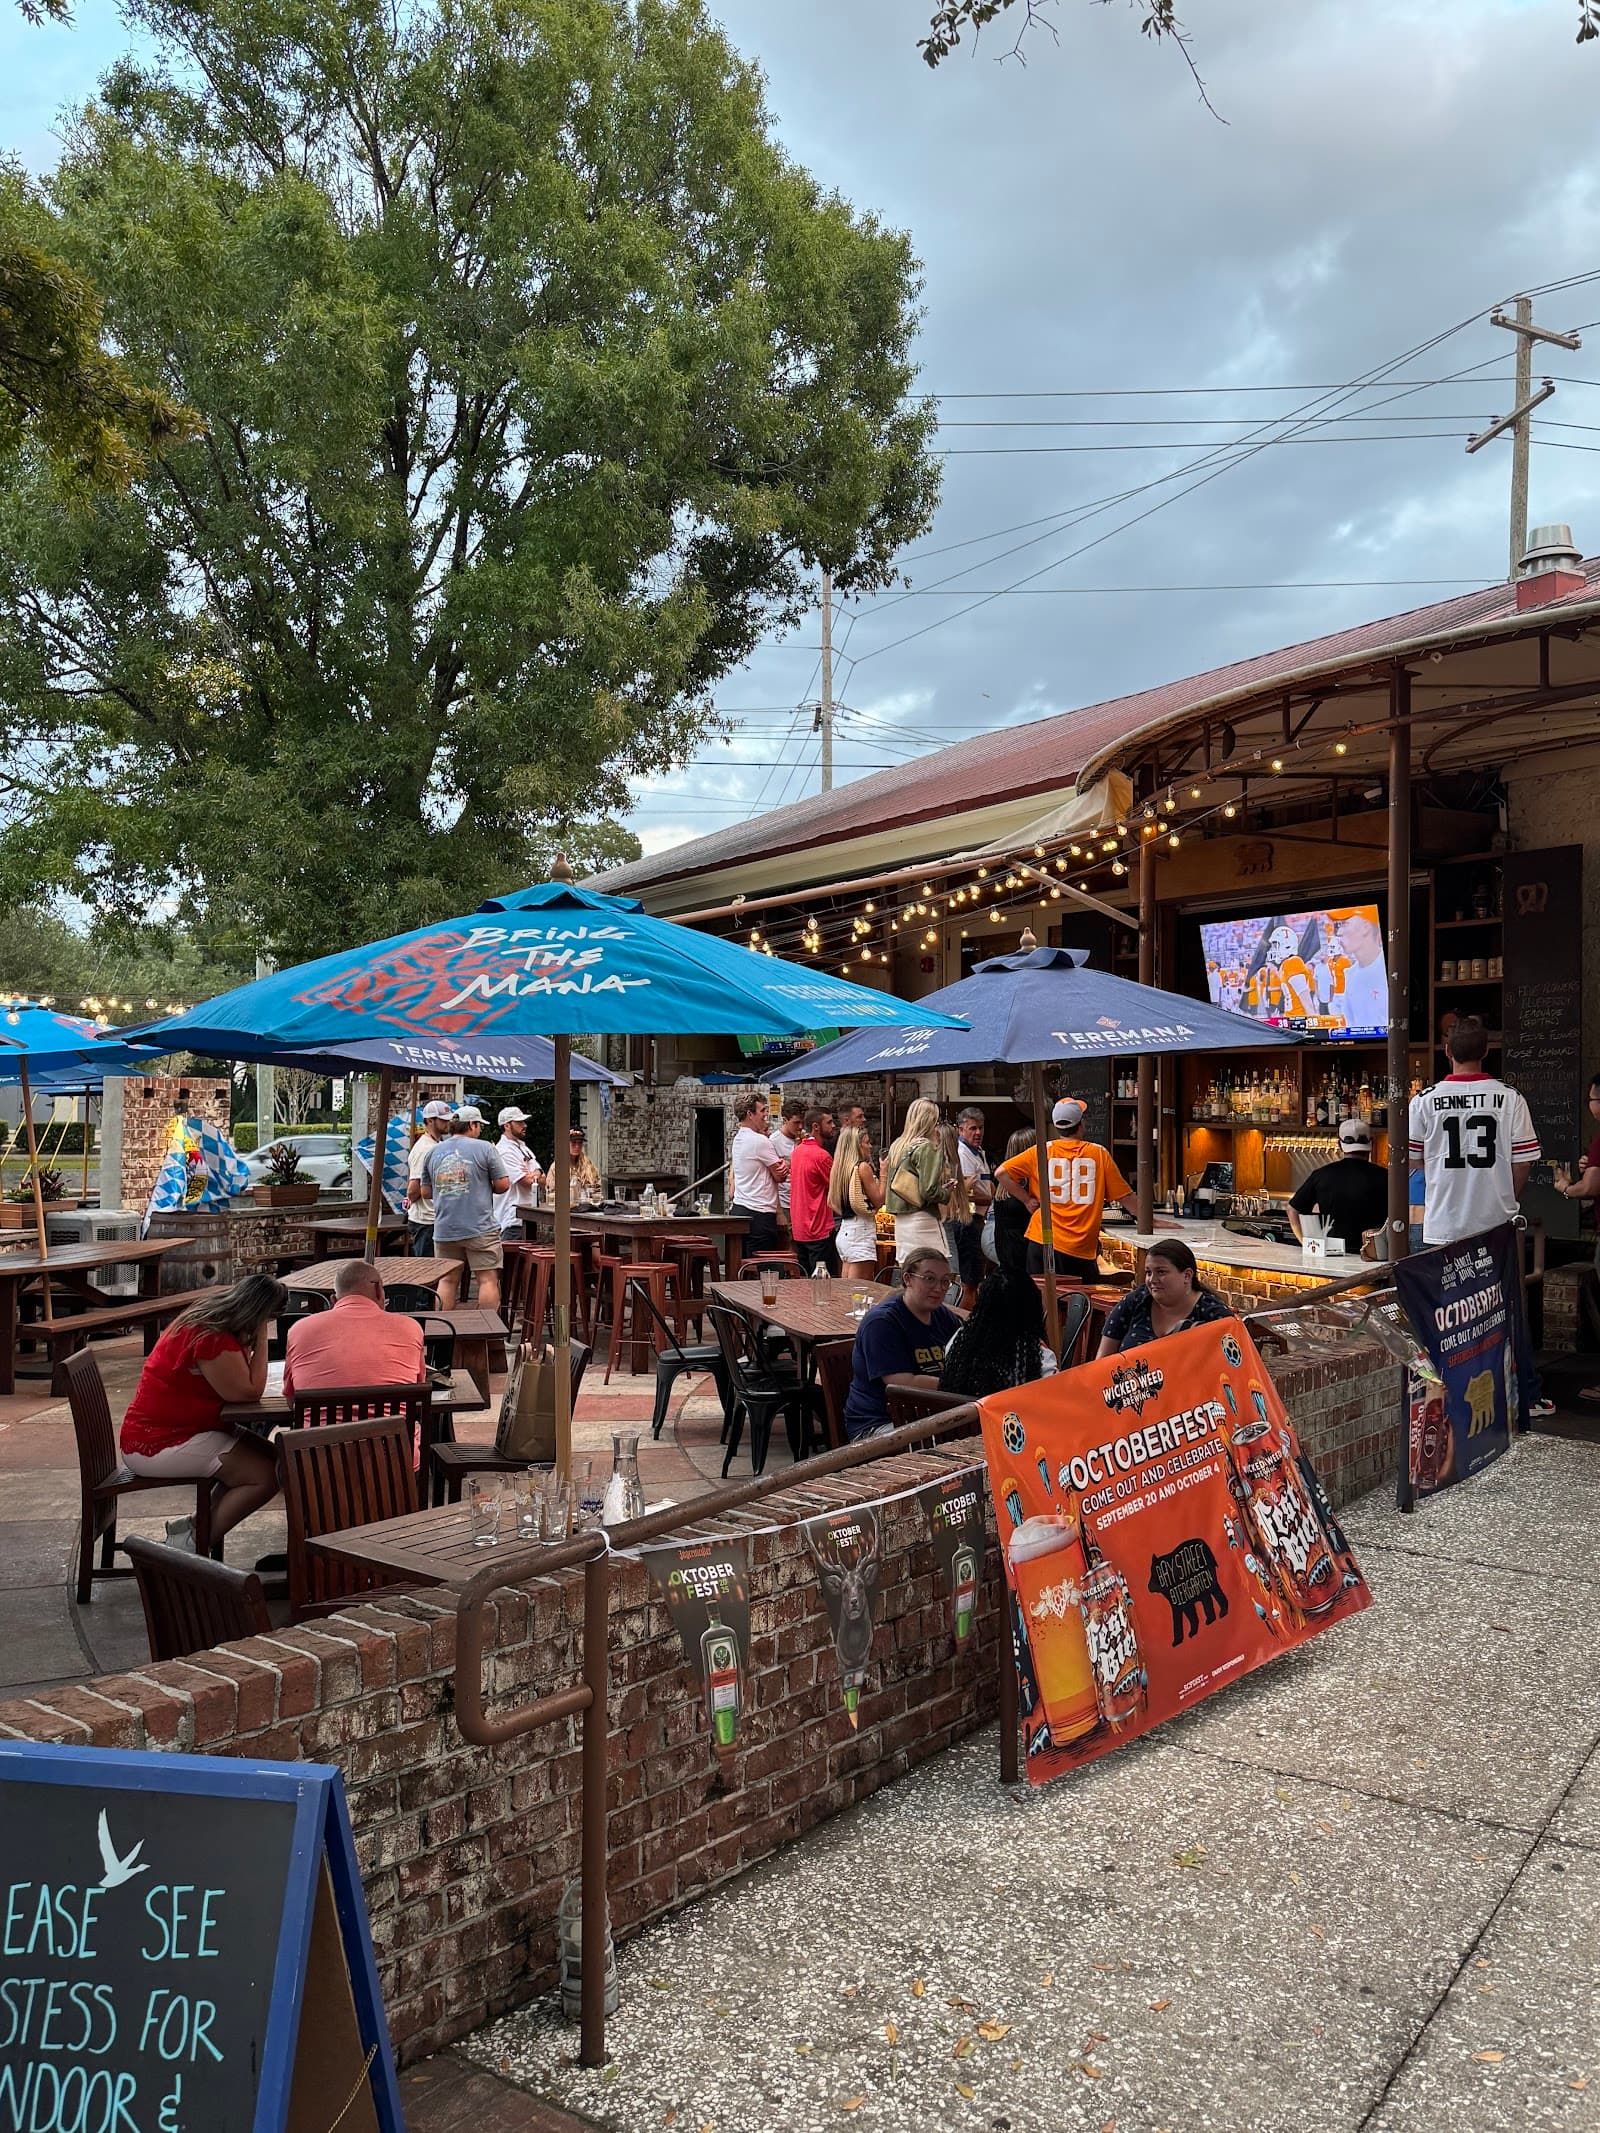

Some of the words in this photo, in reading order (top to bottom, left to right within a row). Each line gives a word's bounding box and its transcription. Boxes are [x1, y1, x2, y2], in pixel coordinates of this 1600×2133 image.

[501, 944, 604, 971] THE
[1051, 1024, 1196, 1044] TEREMANA
[388, 1043, 526, 1067] TEREMANA
[866, 1043, 931, 1063] MANA
[1434, 1094, 1486, 1111] BENNETT
[1493, 1094, 1504, 1109] IV
[1442, 1115, 1497, 1169] 13
[1048, 1157, 1096, 1205] 98
[1435, 1281, 1504, 1332] OCTOBERFEST
[1440, 1336, 1457, 1353] COME
[1457, 1329, 1471, 1344] OUT
[1472, 1322, 1484, 1339] AND
[1102, 1379, 1138, 1402] WICKED
[1138, 1369, 1164, 1388] WEED
[1122, 1390, 1151, 1407] BREWING
[1069, 1401, 1217, 1491] OCTOBERFEST
[1081, 1487, 1115, 1515] COME
[1116, 1475, 1137, 1499] OUT
[1141, 1464, 1166, 1488] AND
[1167, 1438, 1224, 1475] CELEBRATE
[934, 1492, 977, 1517] OKTOBER
[1096, 1499, 1144, 1530] SEPTEMBER
[1145, 1491, 1157, 1506] 20
[1159, 1485, 1176, 1499] AND
[1177, 1469, 1213, 1491] OCTOBER
[1213, 1462, 1220, 1474] 4
[828, 1525, 861, 1540] OKTOBER
[945, 1509, 967, 1528] FEST
[836, 1537, 853, 1548] FEST
[670, 1562, 735, 1585] OKTOBER
[1155, 1560, 1177, 1588] BAY
[1174, 1543, 1208, 1580] STREET
[686, 1580, 719, 1600] FEST
[1169, 1571, 1213, 1606] BIERGARTEN
[141, 1885, 226, 1962] SEE
[139, 1989, 225, 2062] FOR
